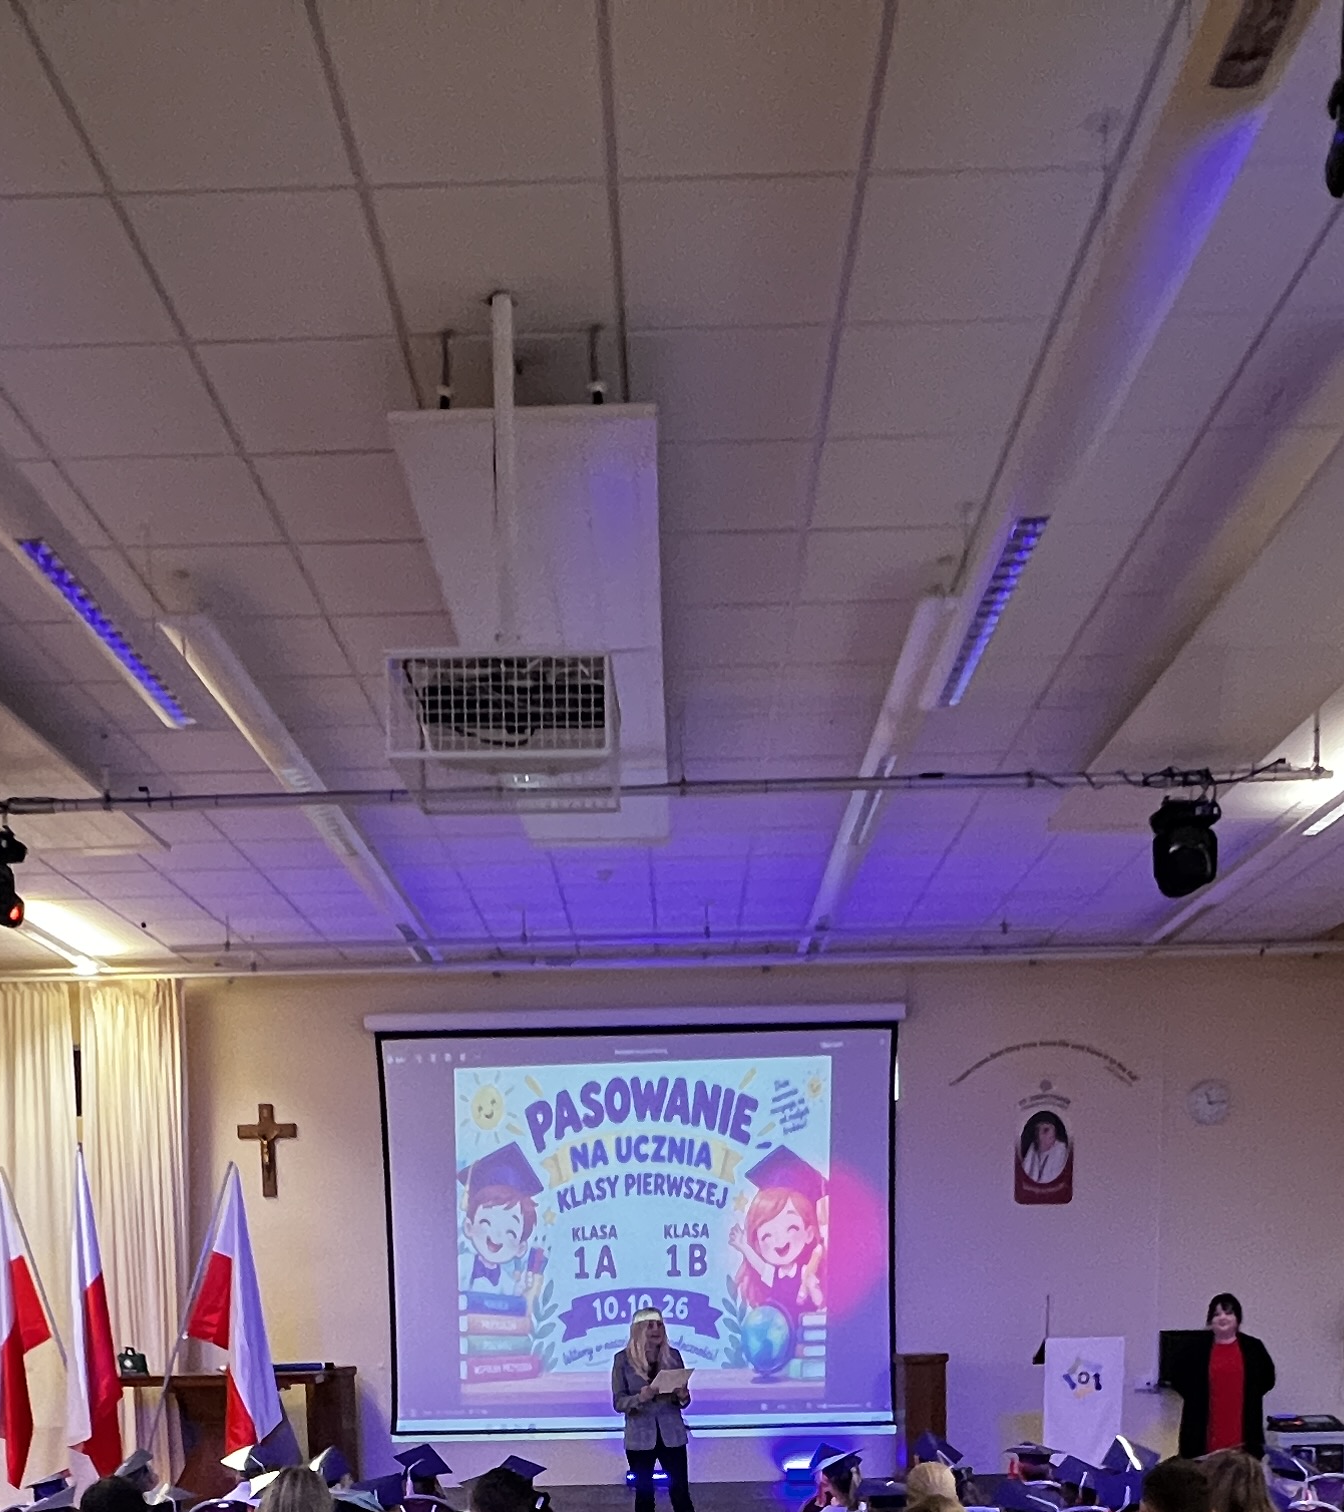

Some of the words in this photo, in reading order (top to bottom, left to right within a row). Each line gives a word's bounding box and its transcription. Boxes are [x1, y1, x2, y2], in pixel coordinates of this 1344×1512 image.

[525, 1076, 759, 1153] PASOWANIE
[569, 1139, 609, 1173] NA
[614, 1134, 712, 1171] UCZNIA
[556, 1174, 619, 1213] KLASY
[624, 1173, 729, 1209] PIERWSZEJ
[571, 1224, 618, 1242] KLASA
[663, 1223, 709, 1240] KLASA
[574, 1244, 617, 1279] 1A
[666, 1243, 708, 1277] 1B
[592, 1293, 689, 1322] 10.1026
